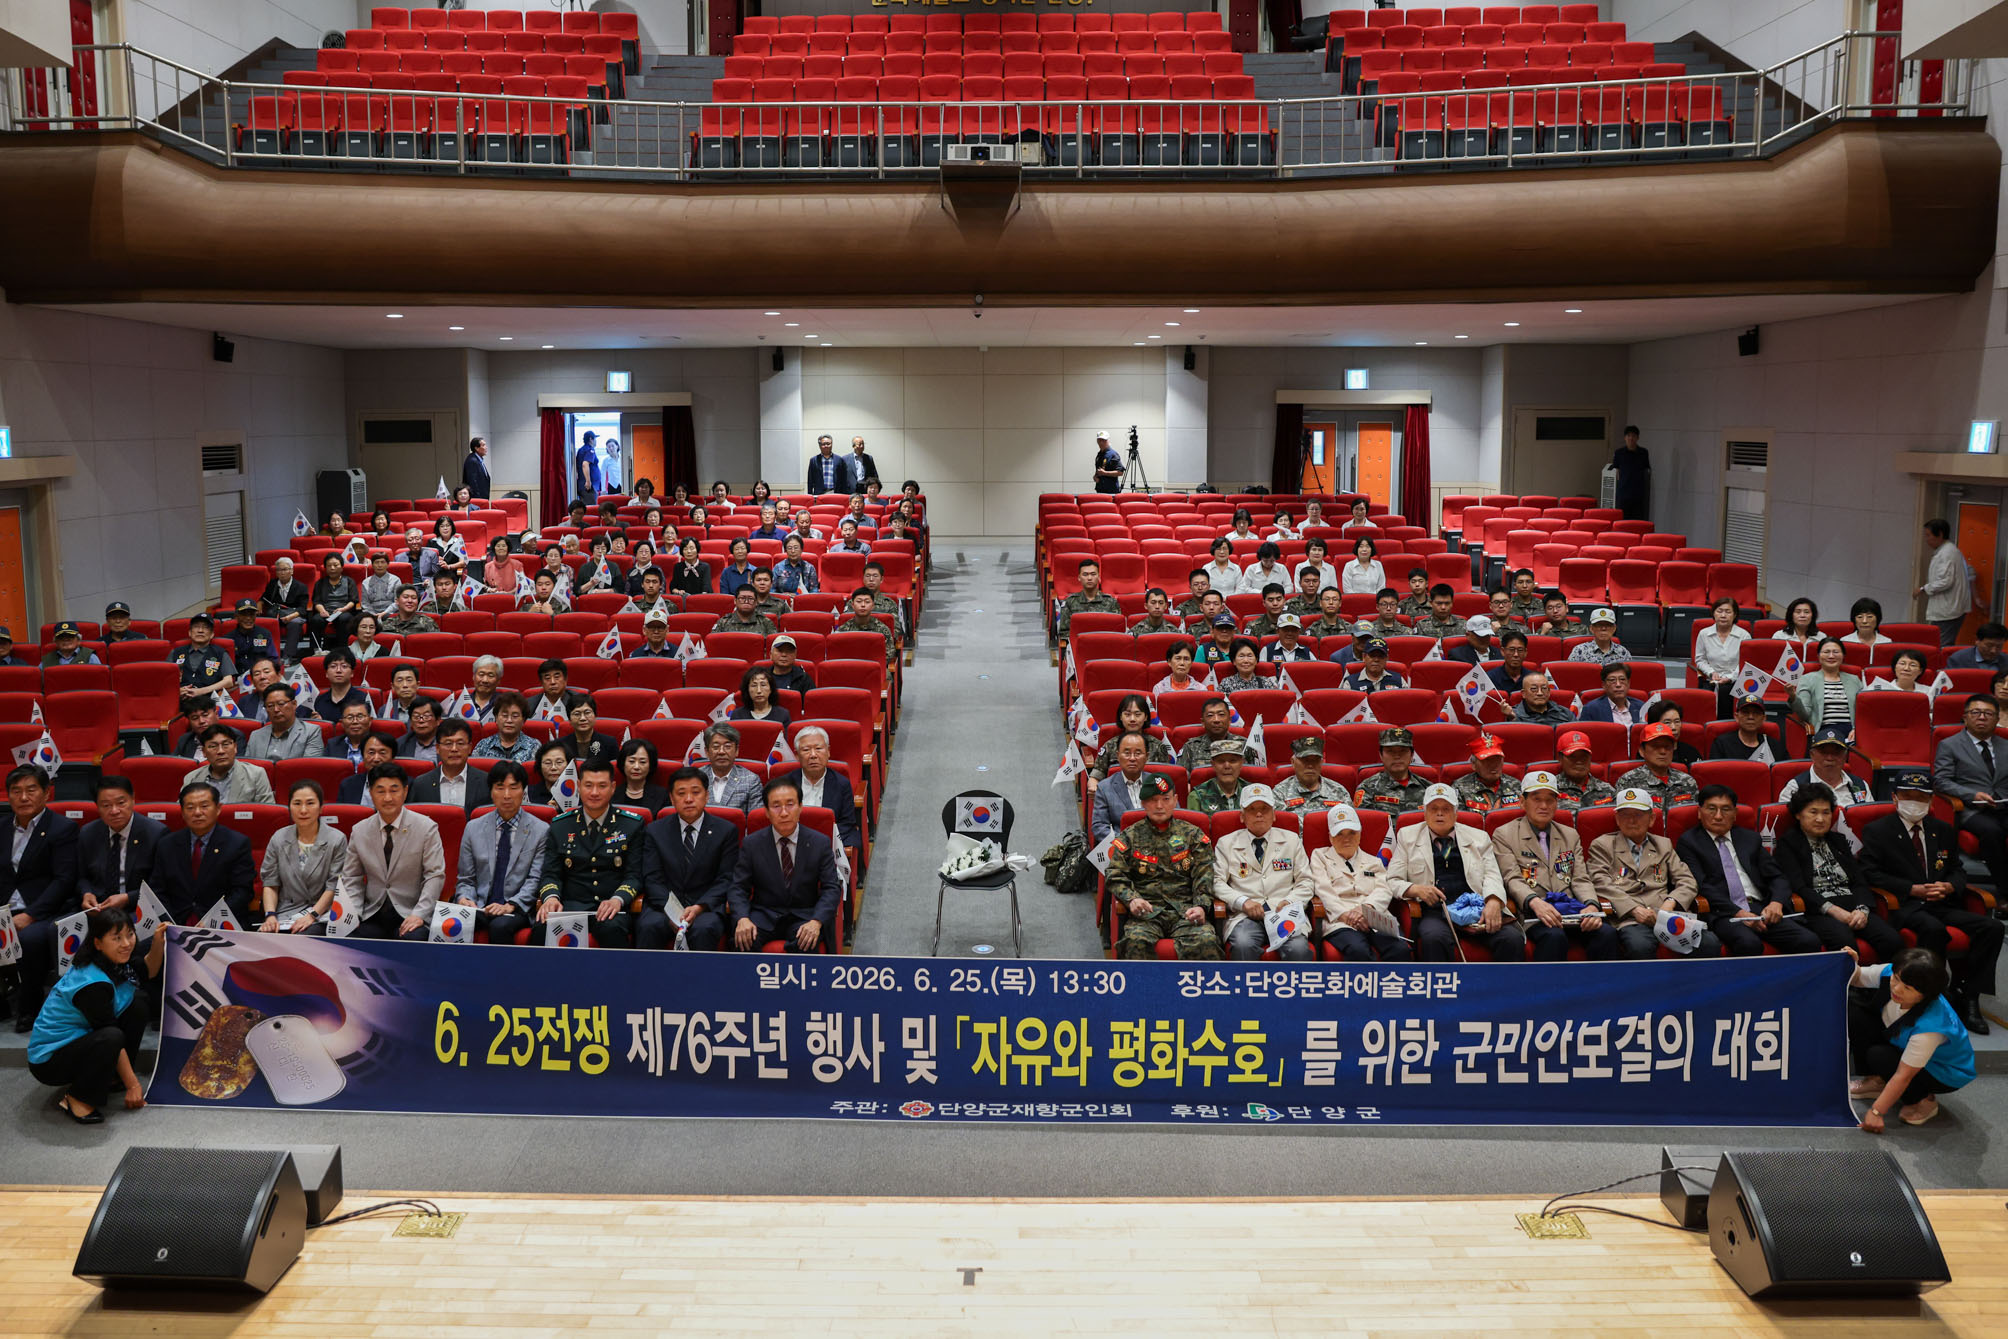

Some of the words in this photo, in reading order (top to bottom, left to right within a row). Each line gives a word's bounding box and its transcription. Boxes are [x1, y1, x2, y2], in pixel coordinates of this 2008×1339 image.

[756, 962, 818, 991] 일시:
[831, 965, 904, 992] 2026.
[914, 967, 939, 993] 6.
[949, 966, 1037, 997] 25.(목)
[1049, 970, 1127, 995] 13:30
[434, 1000, 468, 1067] 6.
[486, 1003, 611, 1075] 25전쟁
[626, 1006, 789, 1079] 제76주년
[805, 1011, 885, 1084] 행사
[902, 1014, 938, 1085] 및
[1301, 1020, 1342, 1086] 를
[1357, 1018, 1440, 1086] 위한
[1452, 1010, 1694, 1084] 군민안보결의
[1711, 1007, 1790, 1081] 대회
[829, 1100, 889, 1115] 주관:
[938, 1102, 1133, 1119] 단양군재향군인회
[1170, 1104, 1230, 1118] 후원:
